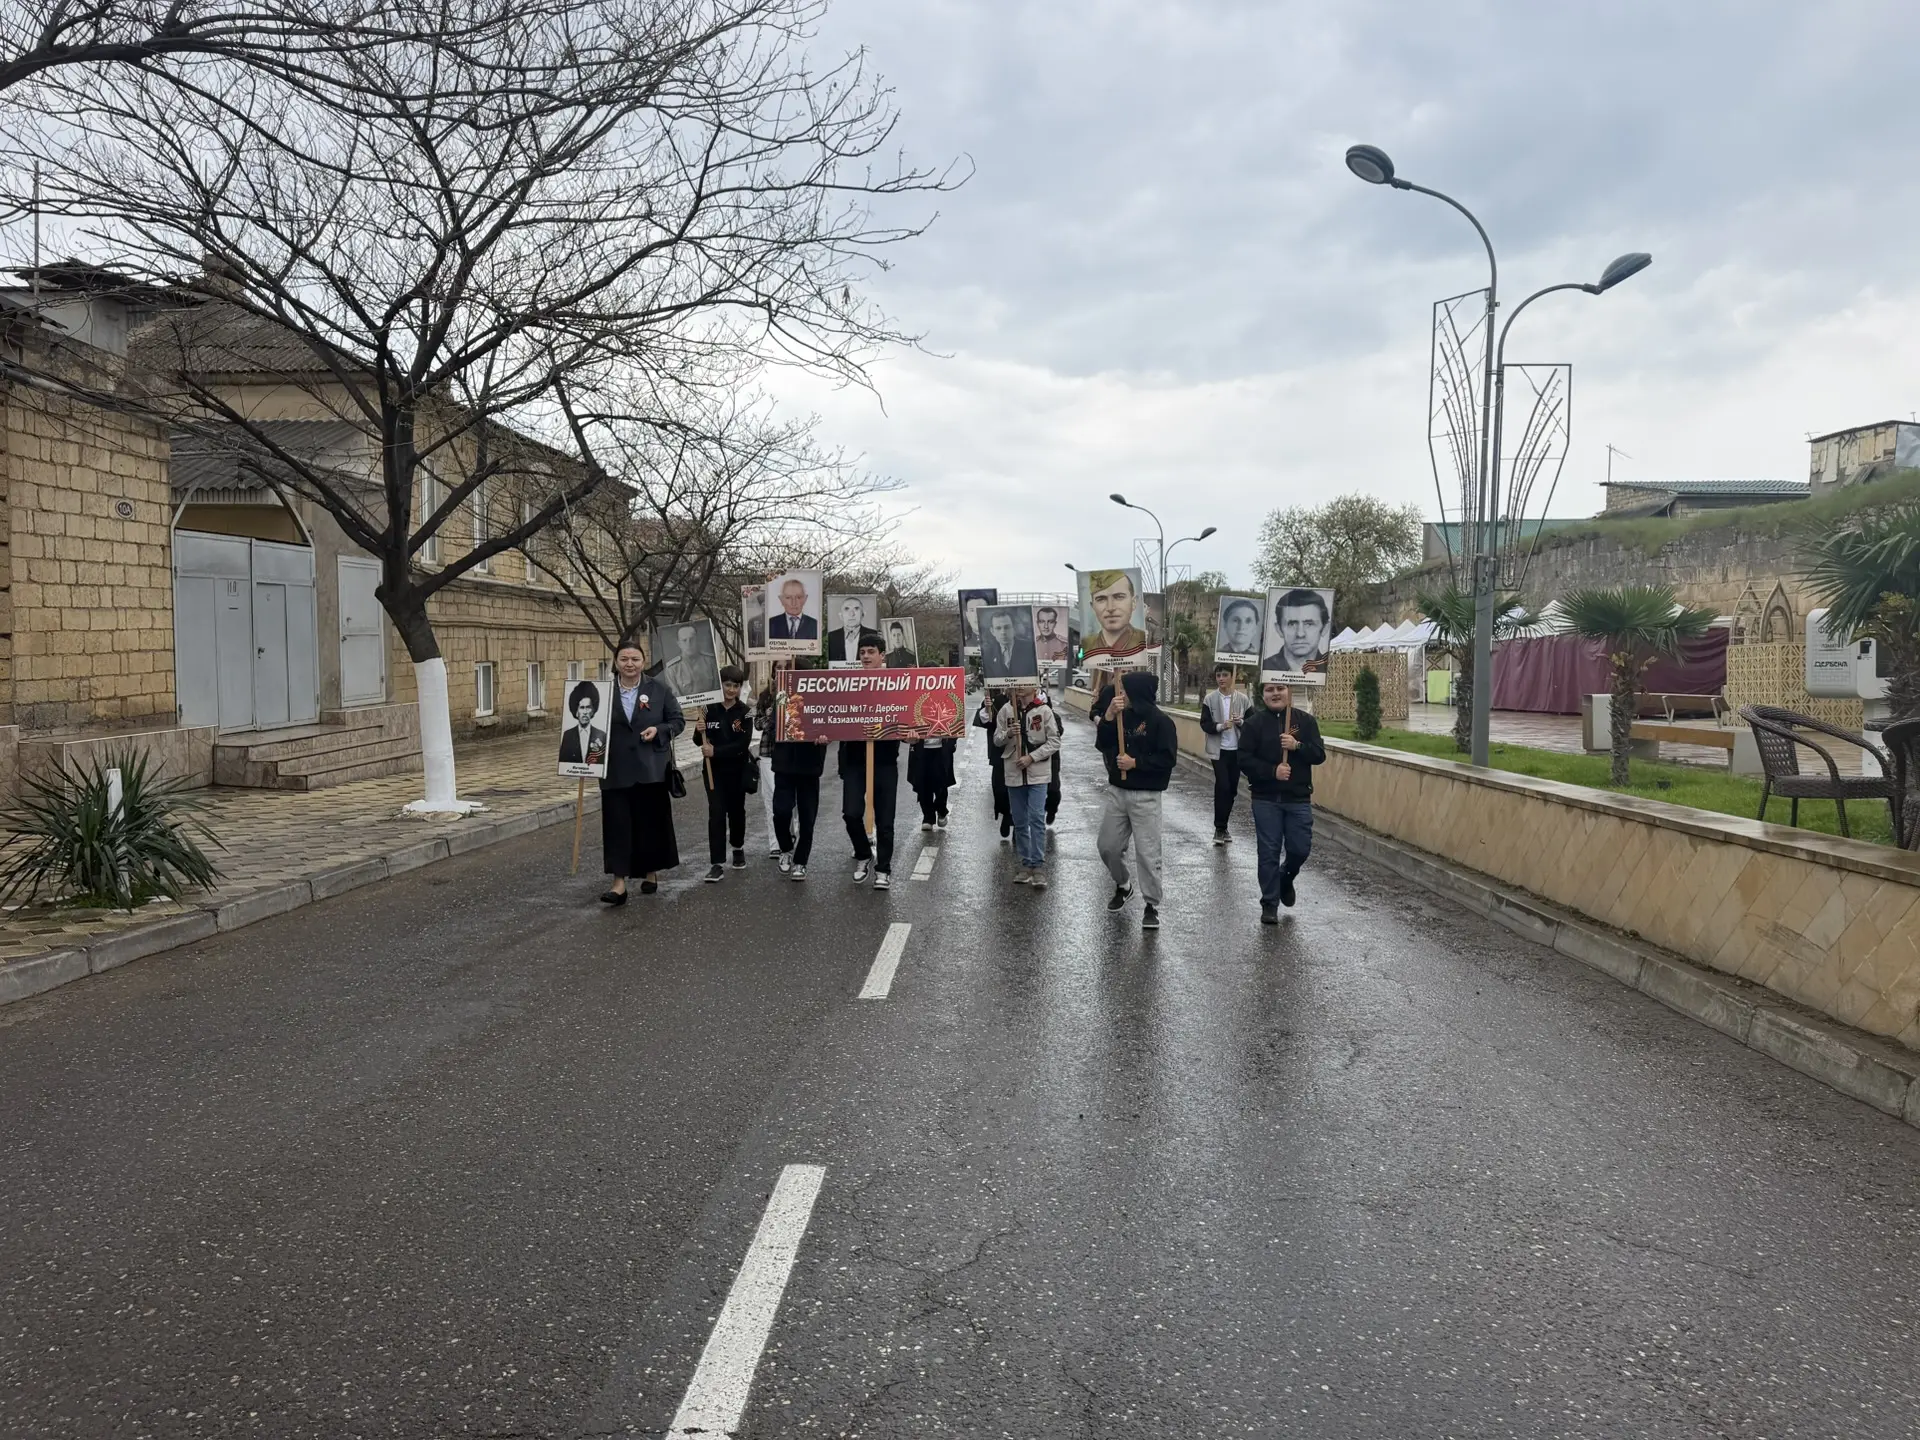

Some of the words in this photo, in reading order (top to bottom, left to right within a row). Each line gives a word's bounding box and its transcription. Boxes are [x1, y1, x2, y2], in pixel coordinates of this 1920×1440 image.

[797, 672, 911, 692] БЕССМЕРТНЫЙ
[915, 675, 957, 690] ПОЛК
[803, 705, 827, 713] МБОУ
[828, 705, 848, 713] СОШ
[850, 704, 867, 713] №17
[875, 703, 908, 713] Дербент
[828, 715, 883, 724] Казиахмедова
[885, 714, 899, 723] С.Г.
[707, 721, 720, 729] UFC
